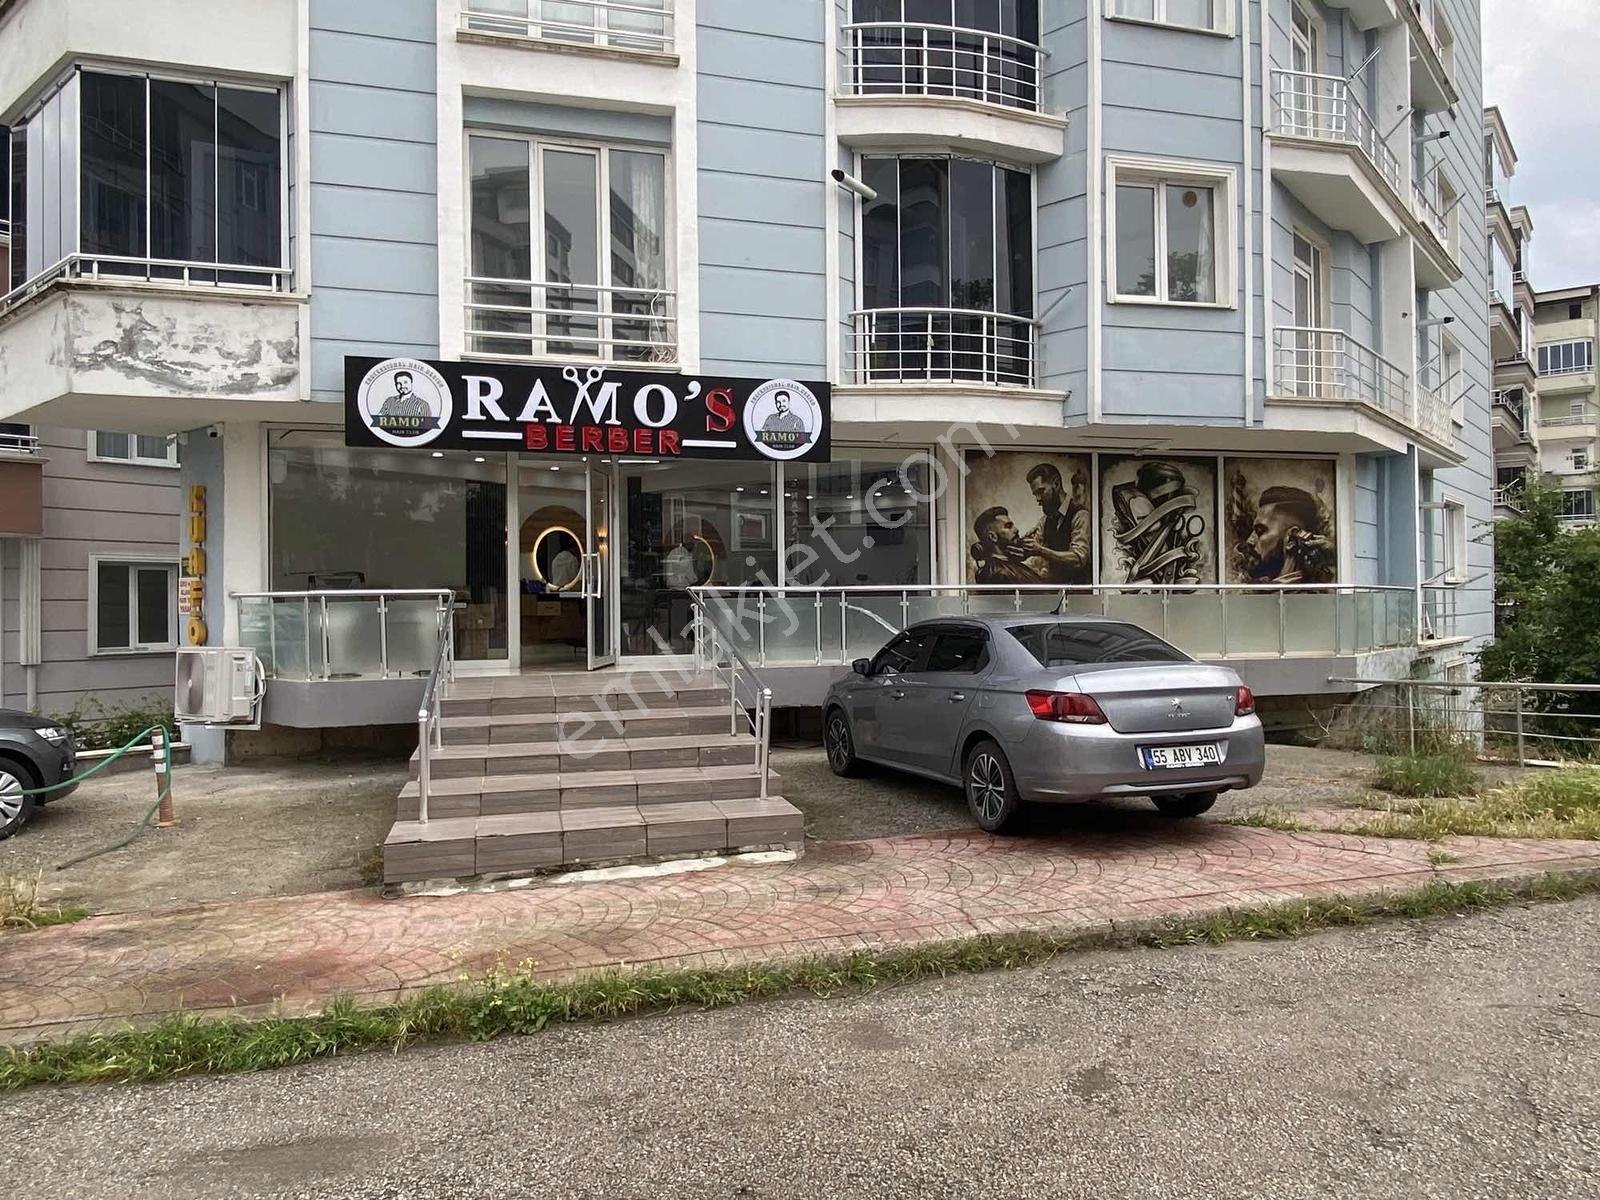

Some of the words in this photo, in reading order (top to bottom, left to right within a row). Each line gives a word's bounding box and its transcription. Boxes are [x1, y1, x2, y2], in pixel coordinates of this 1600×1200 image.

[461, 367, 737, 432] RAMO'S
[526, 424, 684, 455] BERBER
[1152, 749, 1168, 764] 55
[1172, 748, 1192, 763] ABV
[1195, 746, 1216, 761] 340
